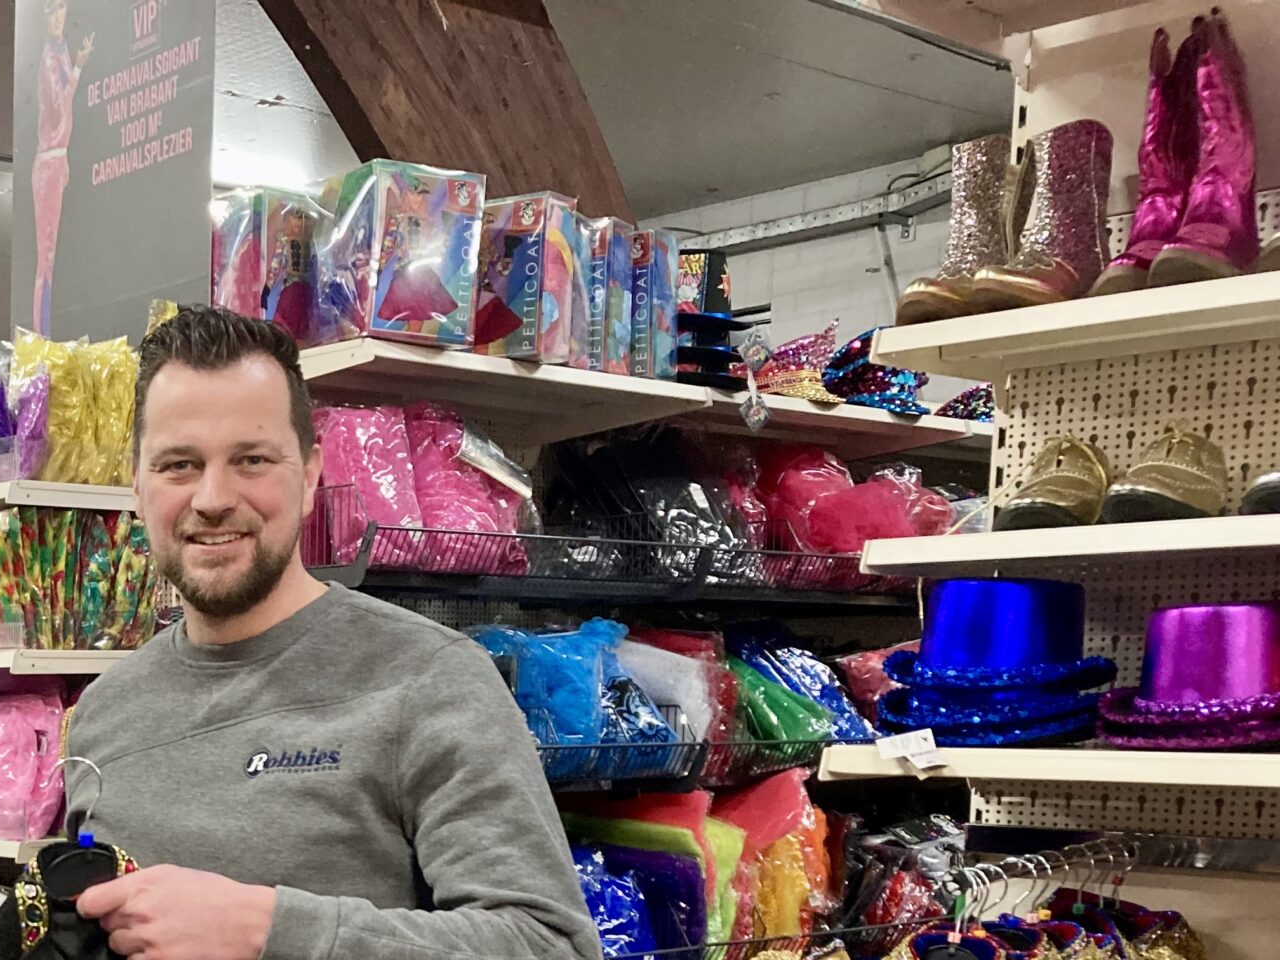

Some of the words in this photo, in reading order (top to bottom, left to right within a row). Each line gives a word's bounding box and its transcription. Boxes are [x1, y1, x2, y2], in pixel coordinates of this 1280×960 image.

[133, 0, 157, 38] VIP
[87, 81, 101, 107] DE
[102, 36, 201, 100] CARNAVALSGIGANT
[107, 97, 128, 126] VAN
[130, 75, 179, 117] BRABANT
[92, 127, 193, 186] CARNAVALSPLEZIER
[120, 117, 146, 148] 1000
[454, 218, 474, 336] PETTICOAT
[522, 234, 540, 350] PETTICOAT
[588, 258, 605, 368] PETTICOAT
[635, 267, 648, 373] PETTICOAT
[247, 747, 340, 773] Robbies
